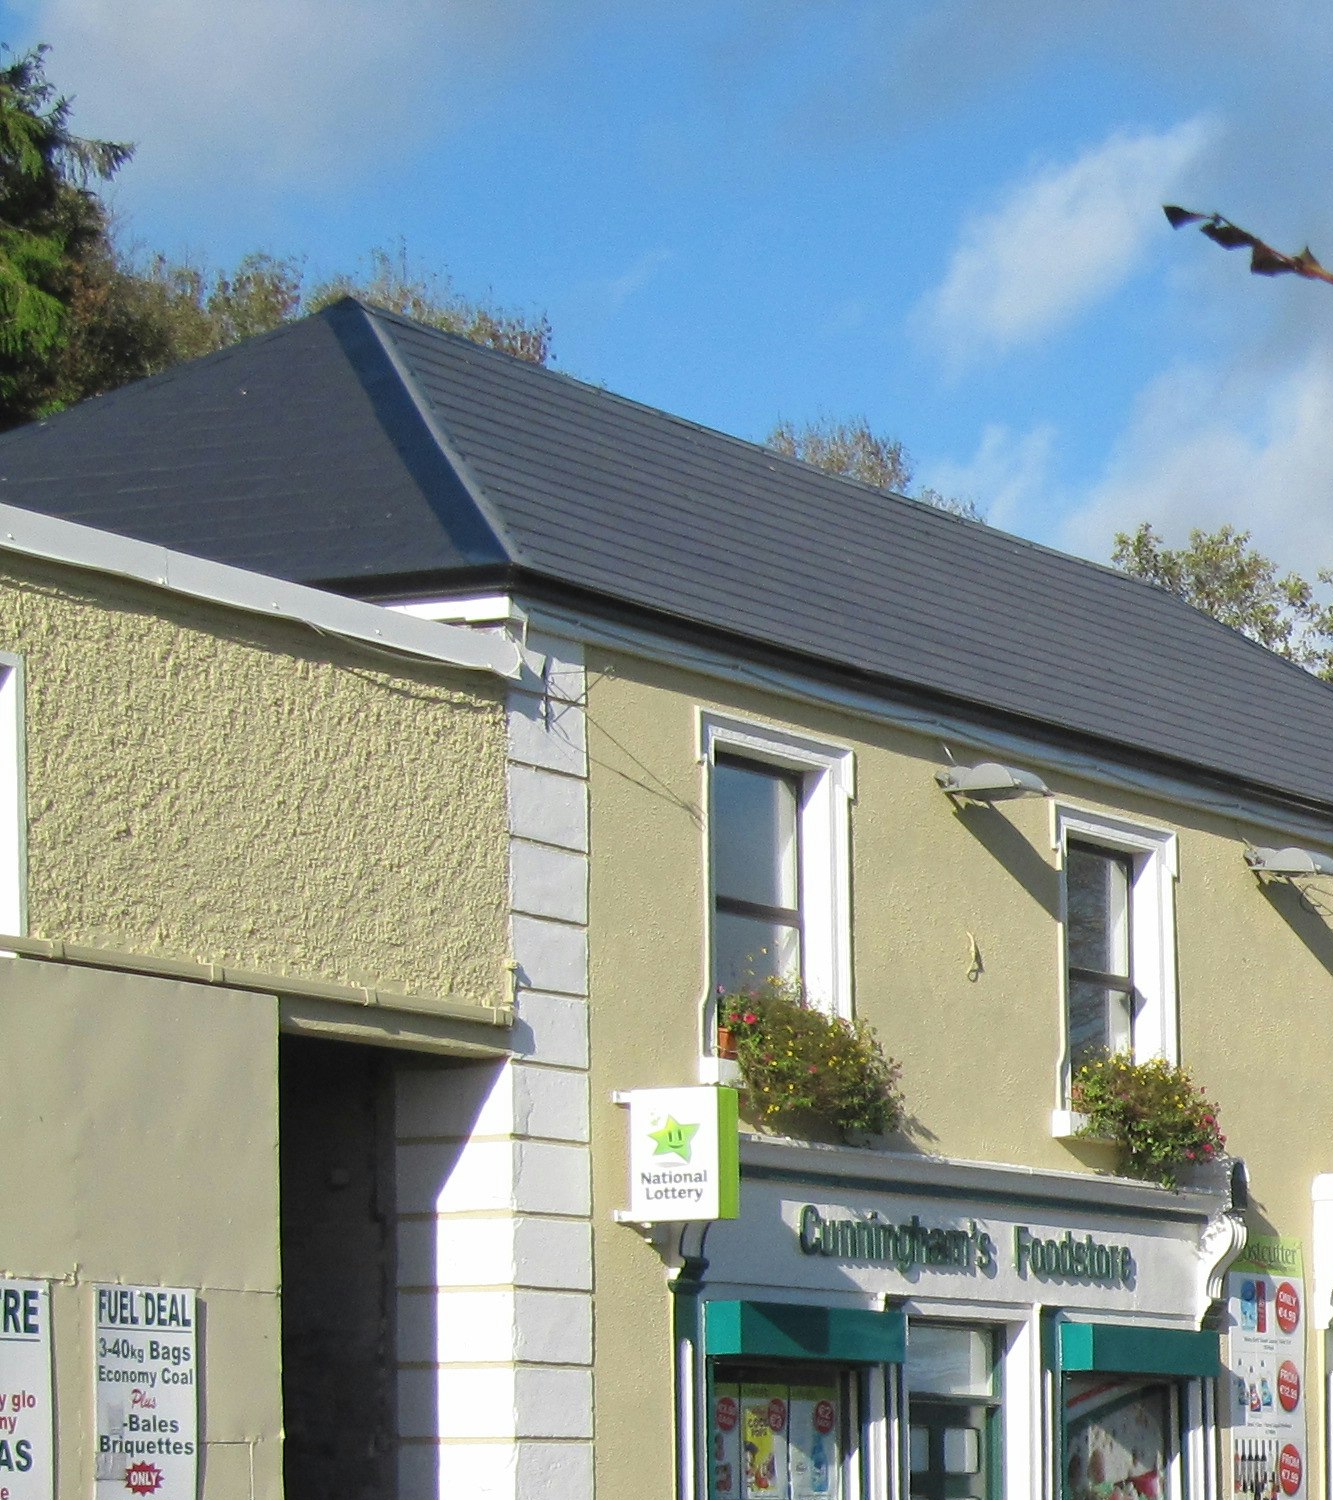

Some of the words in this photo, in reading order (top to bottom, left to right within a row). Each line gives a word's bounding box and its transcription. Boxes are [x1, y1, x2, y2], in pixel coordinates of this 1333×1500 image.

[641, 1169, 708, 1186] National
[645, 1188, 704, 1203] Lottery
[799, 1204, 991, 1275] Cunningham's
[1012, 1225, 1134, 1281] Foodstore
[0, 1289, 39, 1334] RE
[98, 1289, 139, 1325] FUEL
[144, 1292, 192, 1327] DEAL
[99, 1337, 144, 1362] 3-40kg
[149, 1340, 191, 1365] Bags
[98, 1365, 157, 1388] Economy
[161, 1367, 193, 1386] Coal
[11, 1390, 36, 1413] glo
[131, 1388, 157, 1410] Plus
[99, 1435, 194, 1458] Briquettes
[130, 1469, 158, 1486] ONLY
